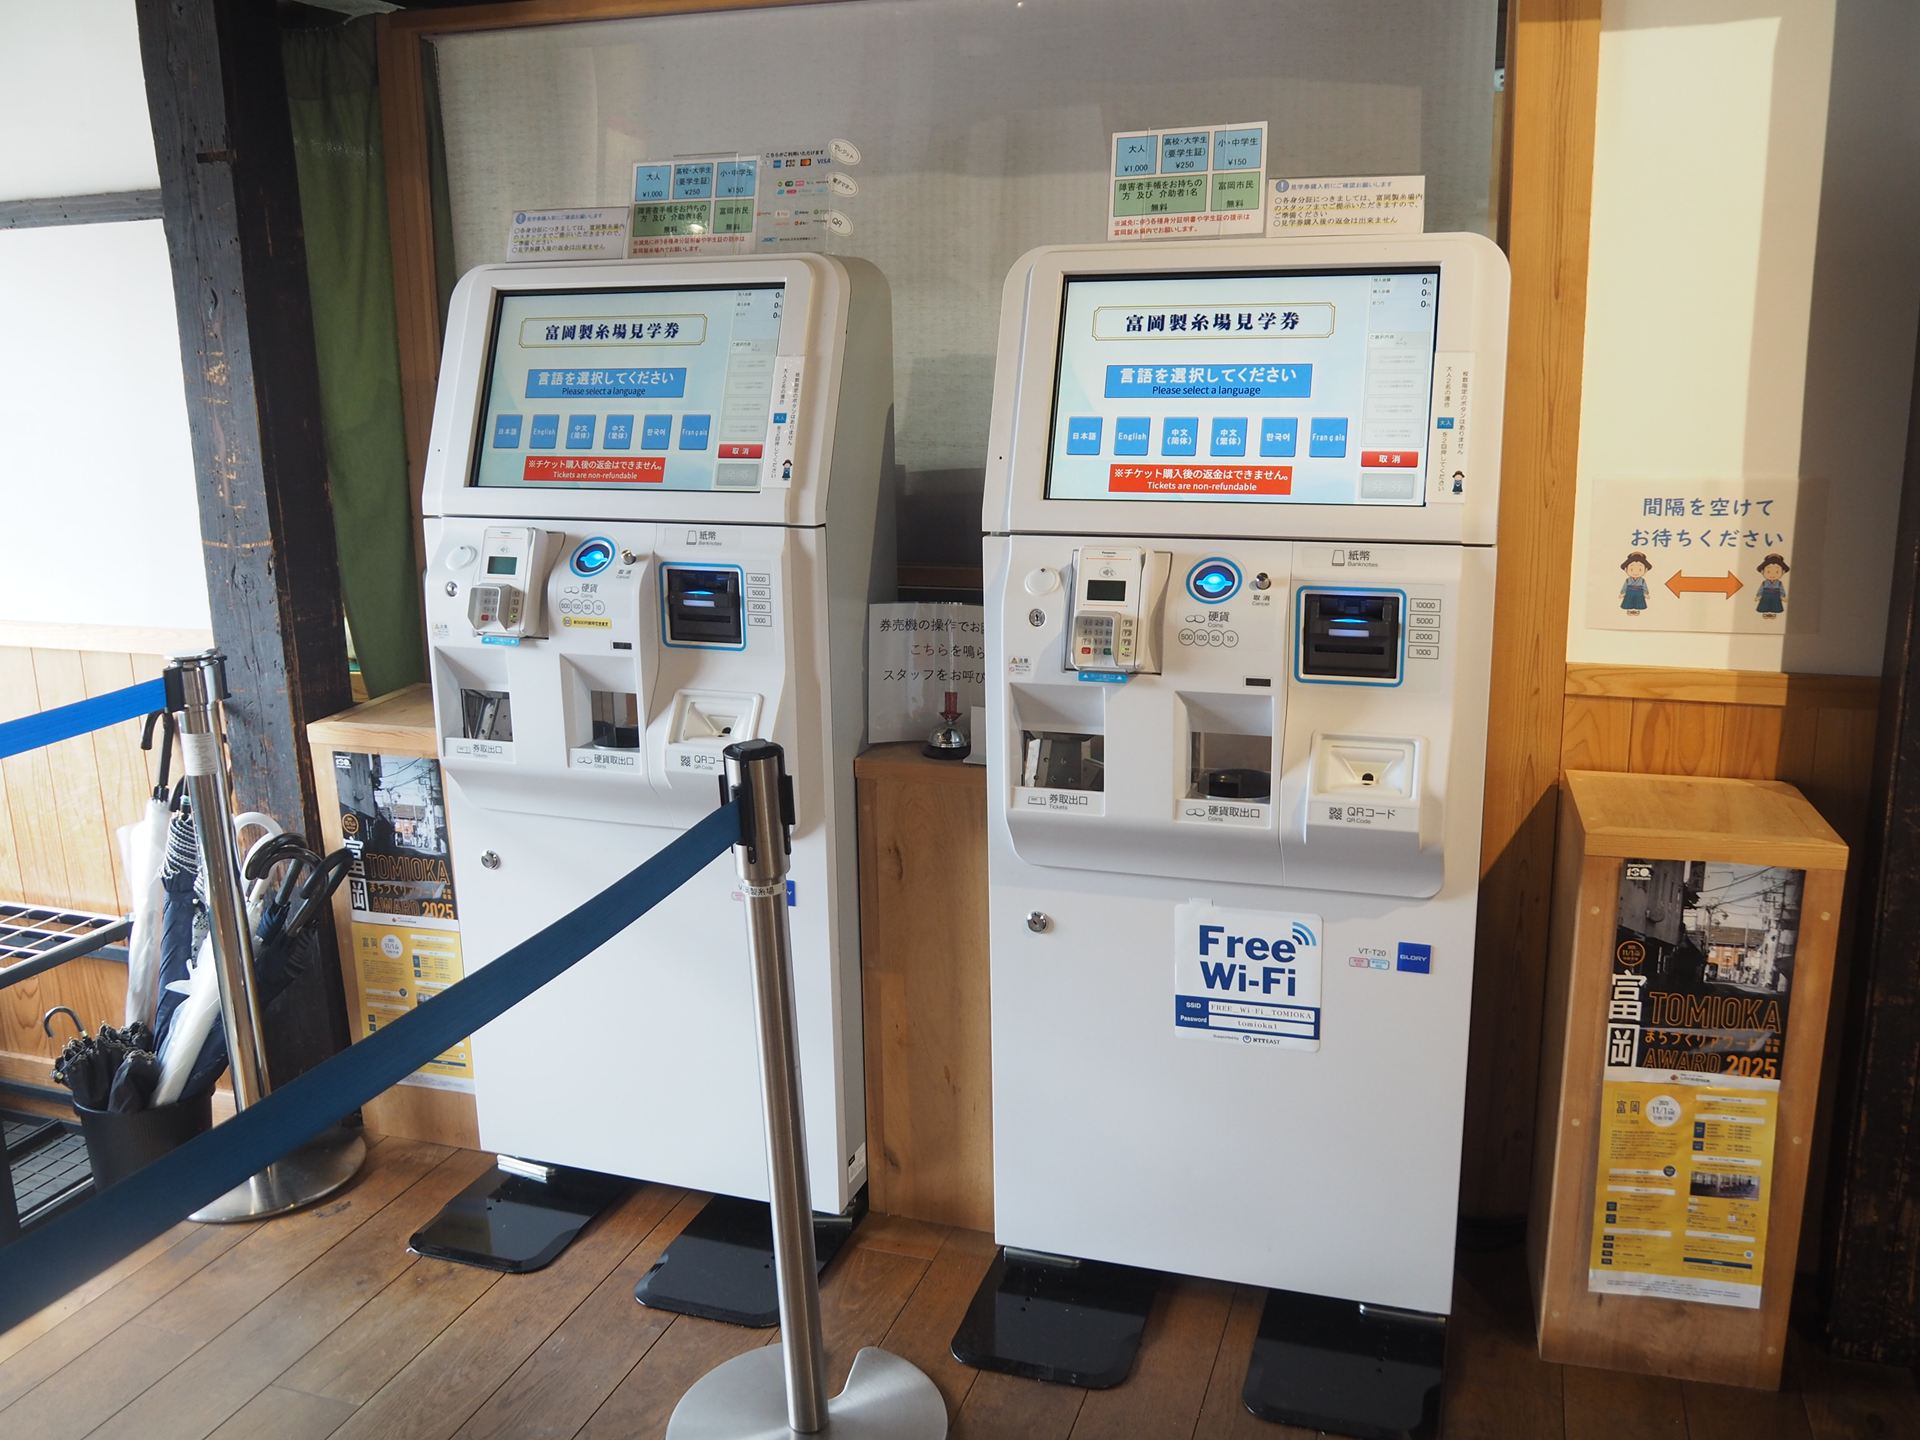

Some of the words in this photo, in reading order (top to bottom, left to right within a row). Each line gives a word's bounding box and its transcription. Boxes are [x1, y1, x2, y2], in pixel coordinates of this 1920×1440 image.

[1164, 135, 1208, 146] 高校・大学生
[1218, 137, 1259, 148] 小・中学生
[1128, 144, 1145, 154] 大人
[1176, 161, 1195, 169] ¥250
[1228, 158, 1247, 166] ¥150
[1124, 164, 1149, 172] ¥1,000
[646, 172, 661, 181] 大人
[1151, 203, 1168, 212] 無料
[1226, 200, 1244, 208] 無料
[1125, 312, 1300, 332] 富岡製糸場見学券
[545, 321, 681, 341] 富岡製糸場見学券
[537, 370, 674, 385] 言語を選択してください
[1119, 367, 1298, 385] 言語を選択してください
[562, 387, 585, 396] Please
[585, 387, 606, 396] select
[612, 387, 646, 397] language
[1152, 386, 1181, 395] Please
[1182, 386, 1209, 395] select
[1218, 386, 1261, 397] language
[533, 428, 555, 437] English
[1072, 432, 1097, 441] 日本語
[1118, 432, 1147, 442] English
[1171, 428, 1189, 437] 中文
[1220, 428, 1238, 437] 中文
[1266, 432, 1291, 442] 한국어
[1378, 454, 1401, 464] 取消
[553, 471, 575, 479] Tickets
[579, 472, 588, 480] are
[587, 471, 638, 480] non-refundable
[1114, 468, 1289, 480] ※チケット購入後の返金はできません。
[1147, 481, 1176, 490] Tickets
[1177, 482, 1191, 490] are
[1192, 481, 1257, 491] non-refundable
[1643, 497, 1775, 517] 間隔を空けて
[1630, 528, 1784, 548] お待ちください
[1348, 550, 1370, 561] 紙幣
[752, 589, 766, 597] 5000
[1208, 611, 1229, 622] 硬貨
[1416, 617, 1434, 625] 5000
[1180, 633, 1194, 641] 500
[1211, 634, 1220, 642] 50
[694, 754, 724, 766] QRコー
[1050, 793, 1088, 805] 券取出口
[1208, 805, 1260, 819] 硬貨取出口
[1347, 806, 1396, 820] QRコード
[366, 853, 451, 885] TOMIOKA
[422, 901, 455, 920] 2025
[1199, 924, 1297, 964] Free
[1358, 947, 1387, 957] VT-T20
[1400, 954, 1428, 962] GLORY
[1200, 960, 1296, 997] Wi-Fi
[1185, 1001, 1202, 1009] SSID
[1649, 991, 1782, 1034] TOMIOKA
[1180, 1015, 1208, 1024] Password
[1607, 969, 1648, 1067] 富岡
[1642, 1047, 1722, 1073] AWARD
[1726, 1055, 1777, 1080] 2025
